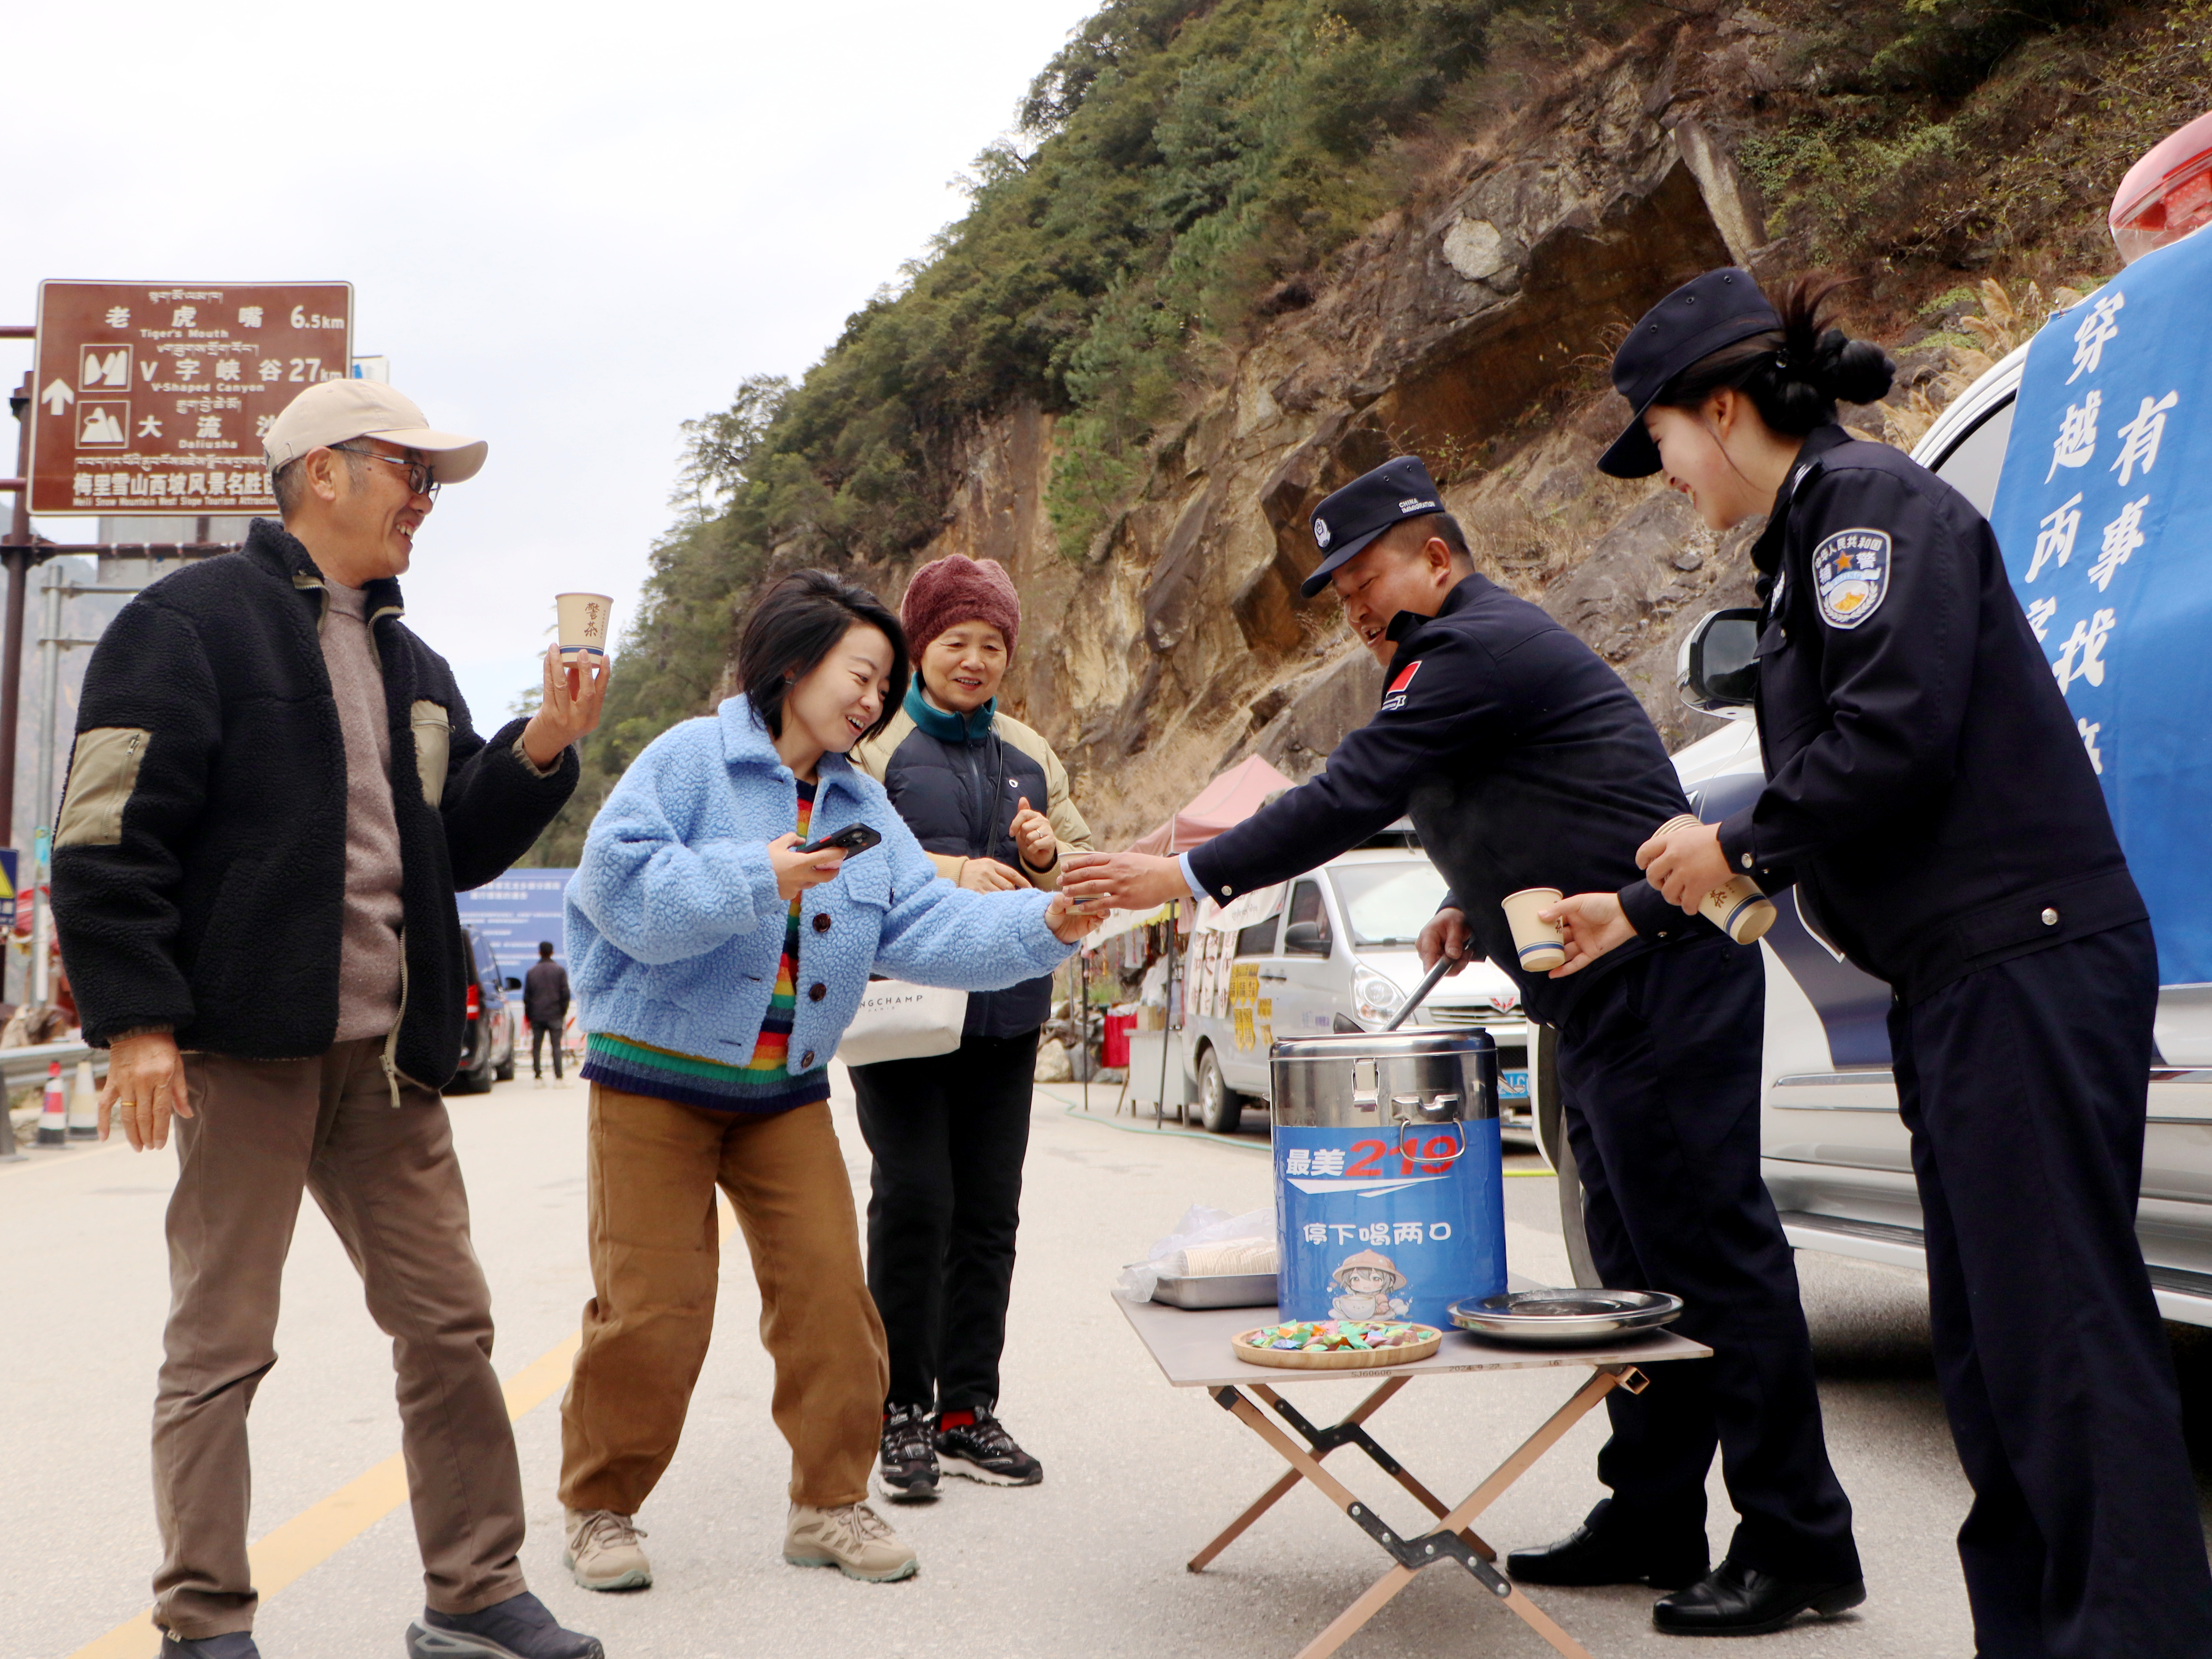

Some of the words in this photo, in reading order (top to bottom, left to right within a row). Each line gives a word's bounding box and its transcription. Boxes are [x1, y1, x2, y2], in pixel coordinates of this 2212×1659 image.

[105, 306, 264, 328] 老虎嘴
[290, 305, 345, 329] 6.5km
[140, 329, 183, 340] Tiger's
[188, 329, 229, 338] Mouth
[289, 357, 343, 382] 27km
[151, 382, 211, 393] V-Shaped
[216, 383, 265, 393] Canyon
[178, 439, 238, 449] Daliusha
[95, 497, 117, 506] Snow
[118, 497, 157, 506] Mountain
[204, 496, 237, 506] Tourism
[239, 496, 278, 505] Attractio
[1399, 498, 1419, 508] CHINA
[1401, 500, 1436, 514] IMMIGRATION
[1815, 535, 1883, 569] 中华人民共和国
[584, 602, 599, 637] 警茶
[1302, 1222, 1452, 1246] 停下喝两口
